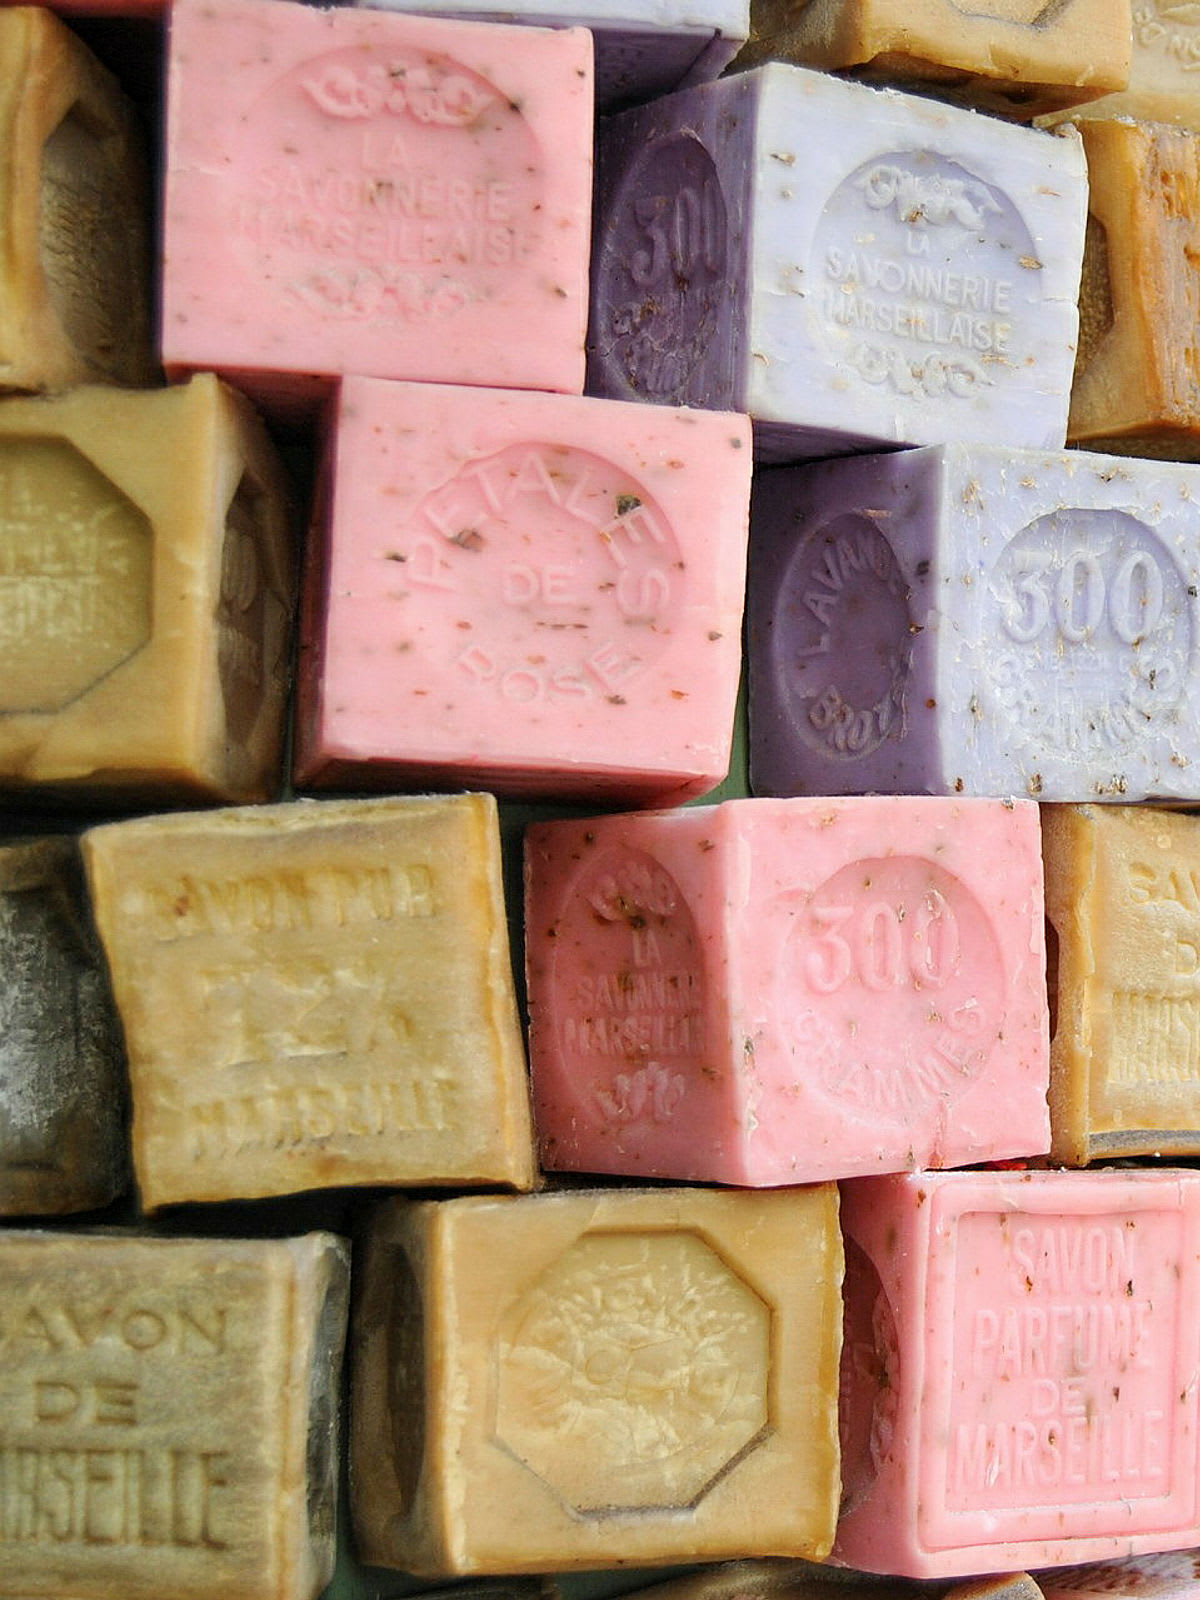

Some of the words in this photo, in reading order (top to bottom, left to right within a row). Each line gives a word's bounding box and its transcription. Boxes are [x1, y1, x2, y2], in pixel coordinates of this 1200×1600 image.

[362, 131, 412, 170] LA
[907, 229, 931, 256] LA
[825, 246, 1013, 315] SAVONNERIE
[822, 283, 1013, 351] MARSEILLAISE
[503, 565, 577, 606] DE
[999, 548, 1165, 646] 300
[456, 645, 644, 702] ROSE
[631, 929, 662, 968] LA
[803, 895, 961, 996] 300
[1008, 1227, 1137, 1298] SAVON
[0, 1304, 229, 1352] AVON
[33, 1380, 141, 1426] DE
[1032, 1378, 1087, 1417] DE
[955, 1409, 1165, 1492] MARSEILLE
